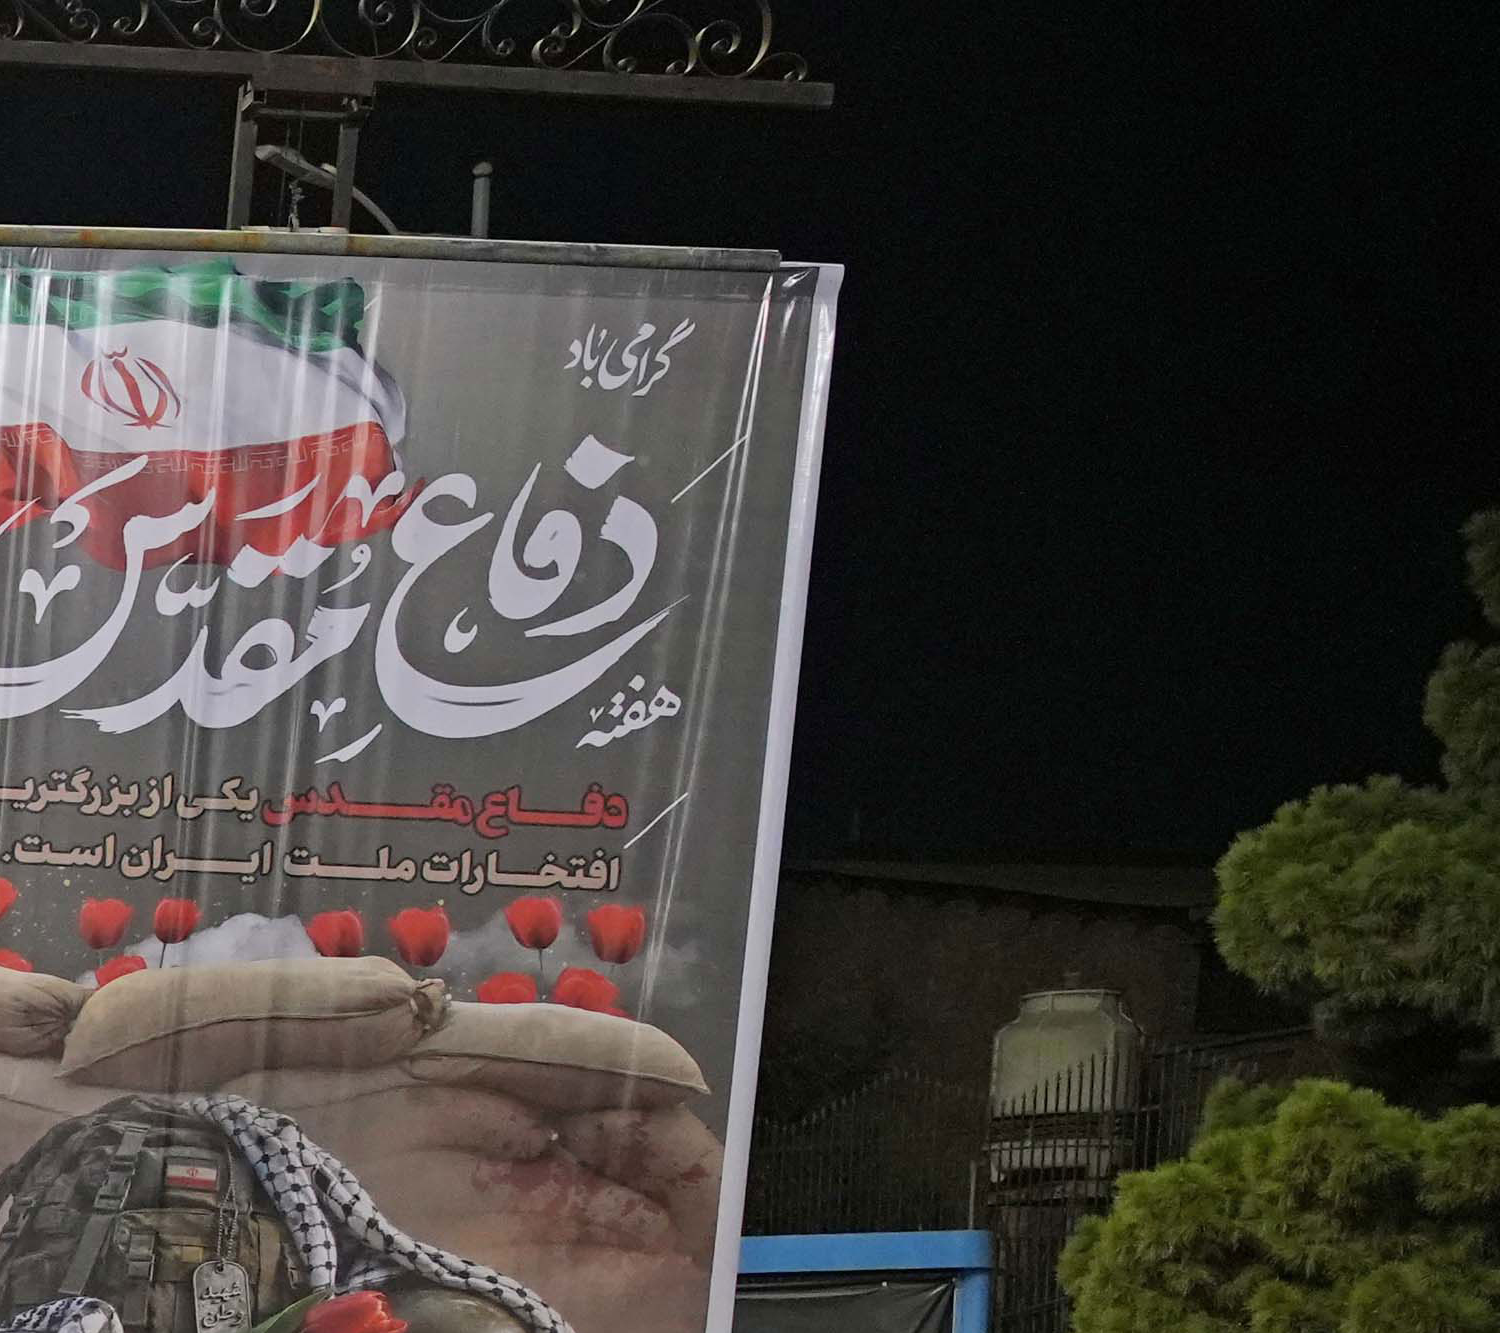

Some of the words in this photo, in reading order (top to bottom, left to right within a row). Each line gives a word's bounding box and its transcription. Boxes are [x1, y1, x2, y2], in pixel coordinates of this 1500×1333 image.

[604, 318, 695, 398] گرامی
[375, 432, 690, 740] دفاع
[576, 672, 683, 751] هفته
[138, 773, 174, 819] از
[176, 776, 260, 822] یکی
[262, 782, 475, 826] مقدس
[474, 781, 629, 839] دفاع
[119, 834, 273, 883] ایران
[283, 845, 417, 885] ملت
[421, 847, 621, 895] افتخارات
[200, 1281, 241, 1304] شهید
[202, 1304, 244, 1328] وطن
